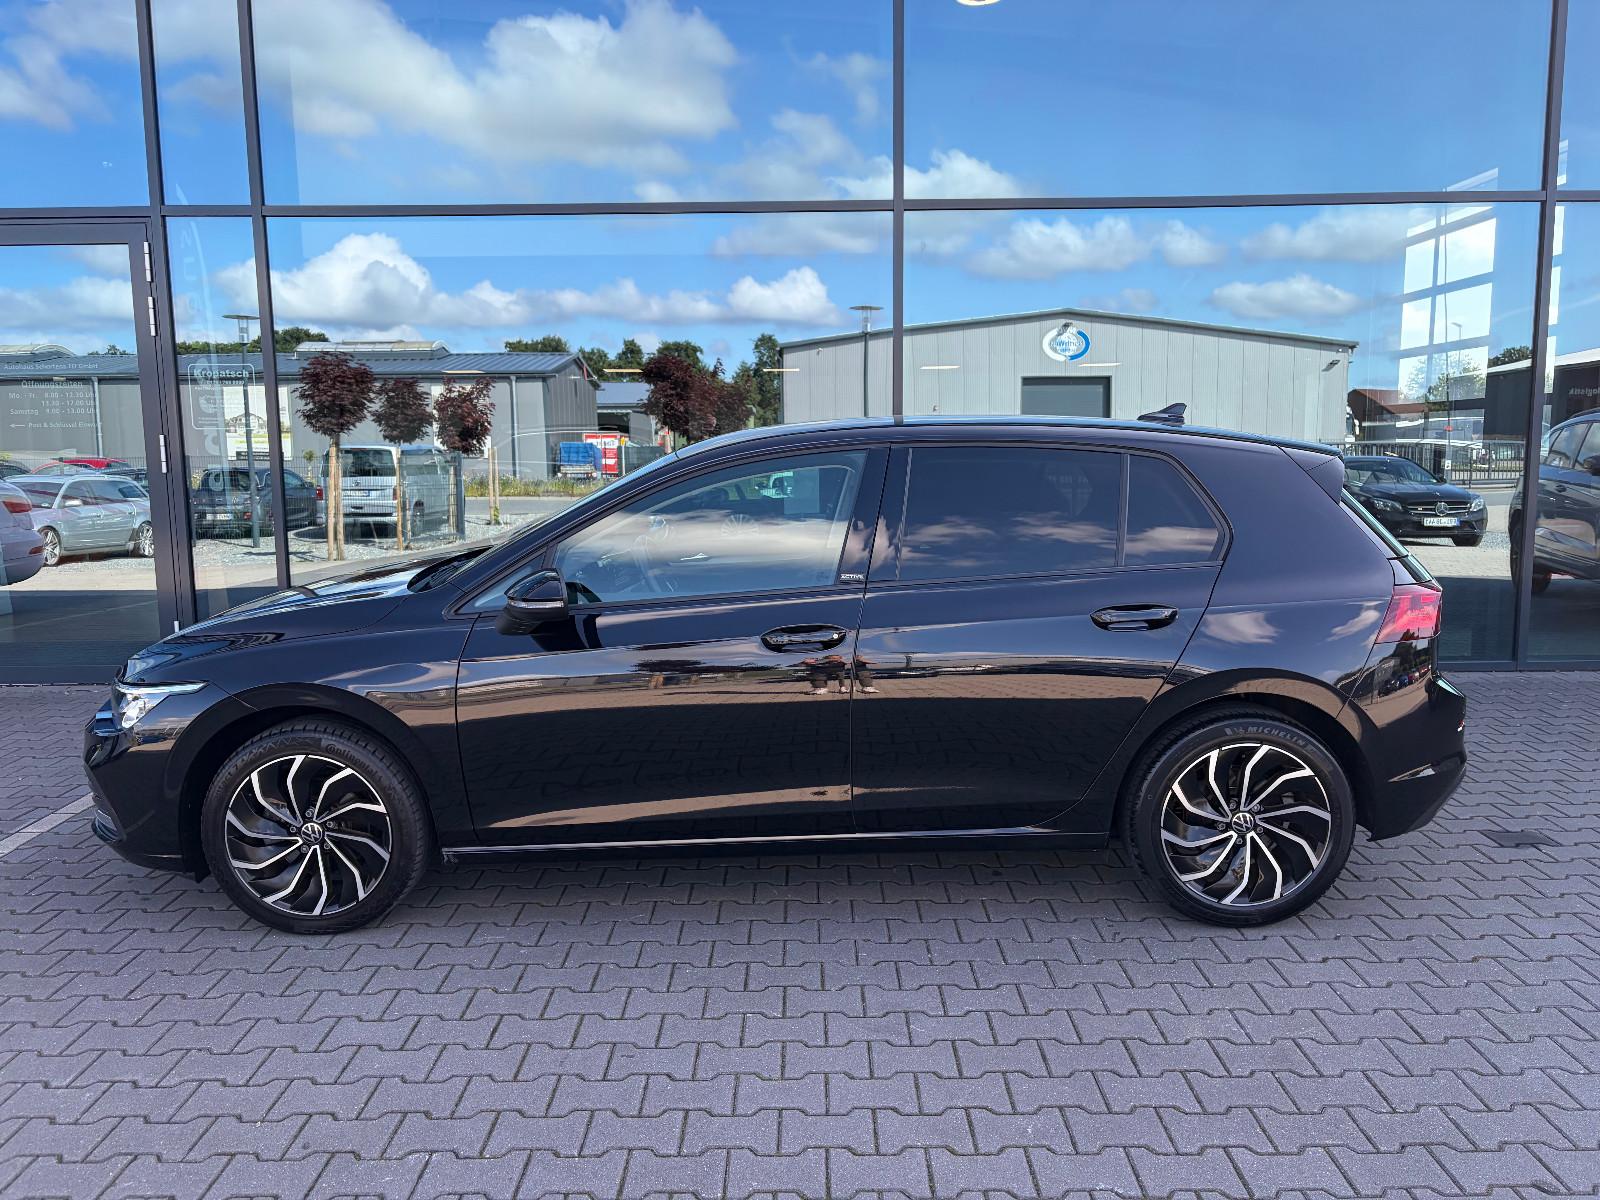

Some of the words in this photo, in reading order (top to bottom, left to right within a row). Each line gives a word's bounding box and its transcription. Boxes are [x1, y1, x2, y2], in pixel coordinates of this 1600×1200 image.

[193, 368, 250, 379] Kropatsch
[1246, 726, 1307, 747] MICHELIN
[326, 743, 385, 782] Continental
